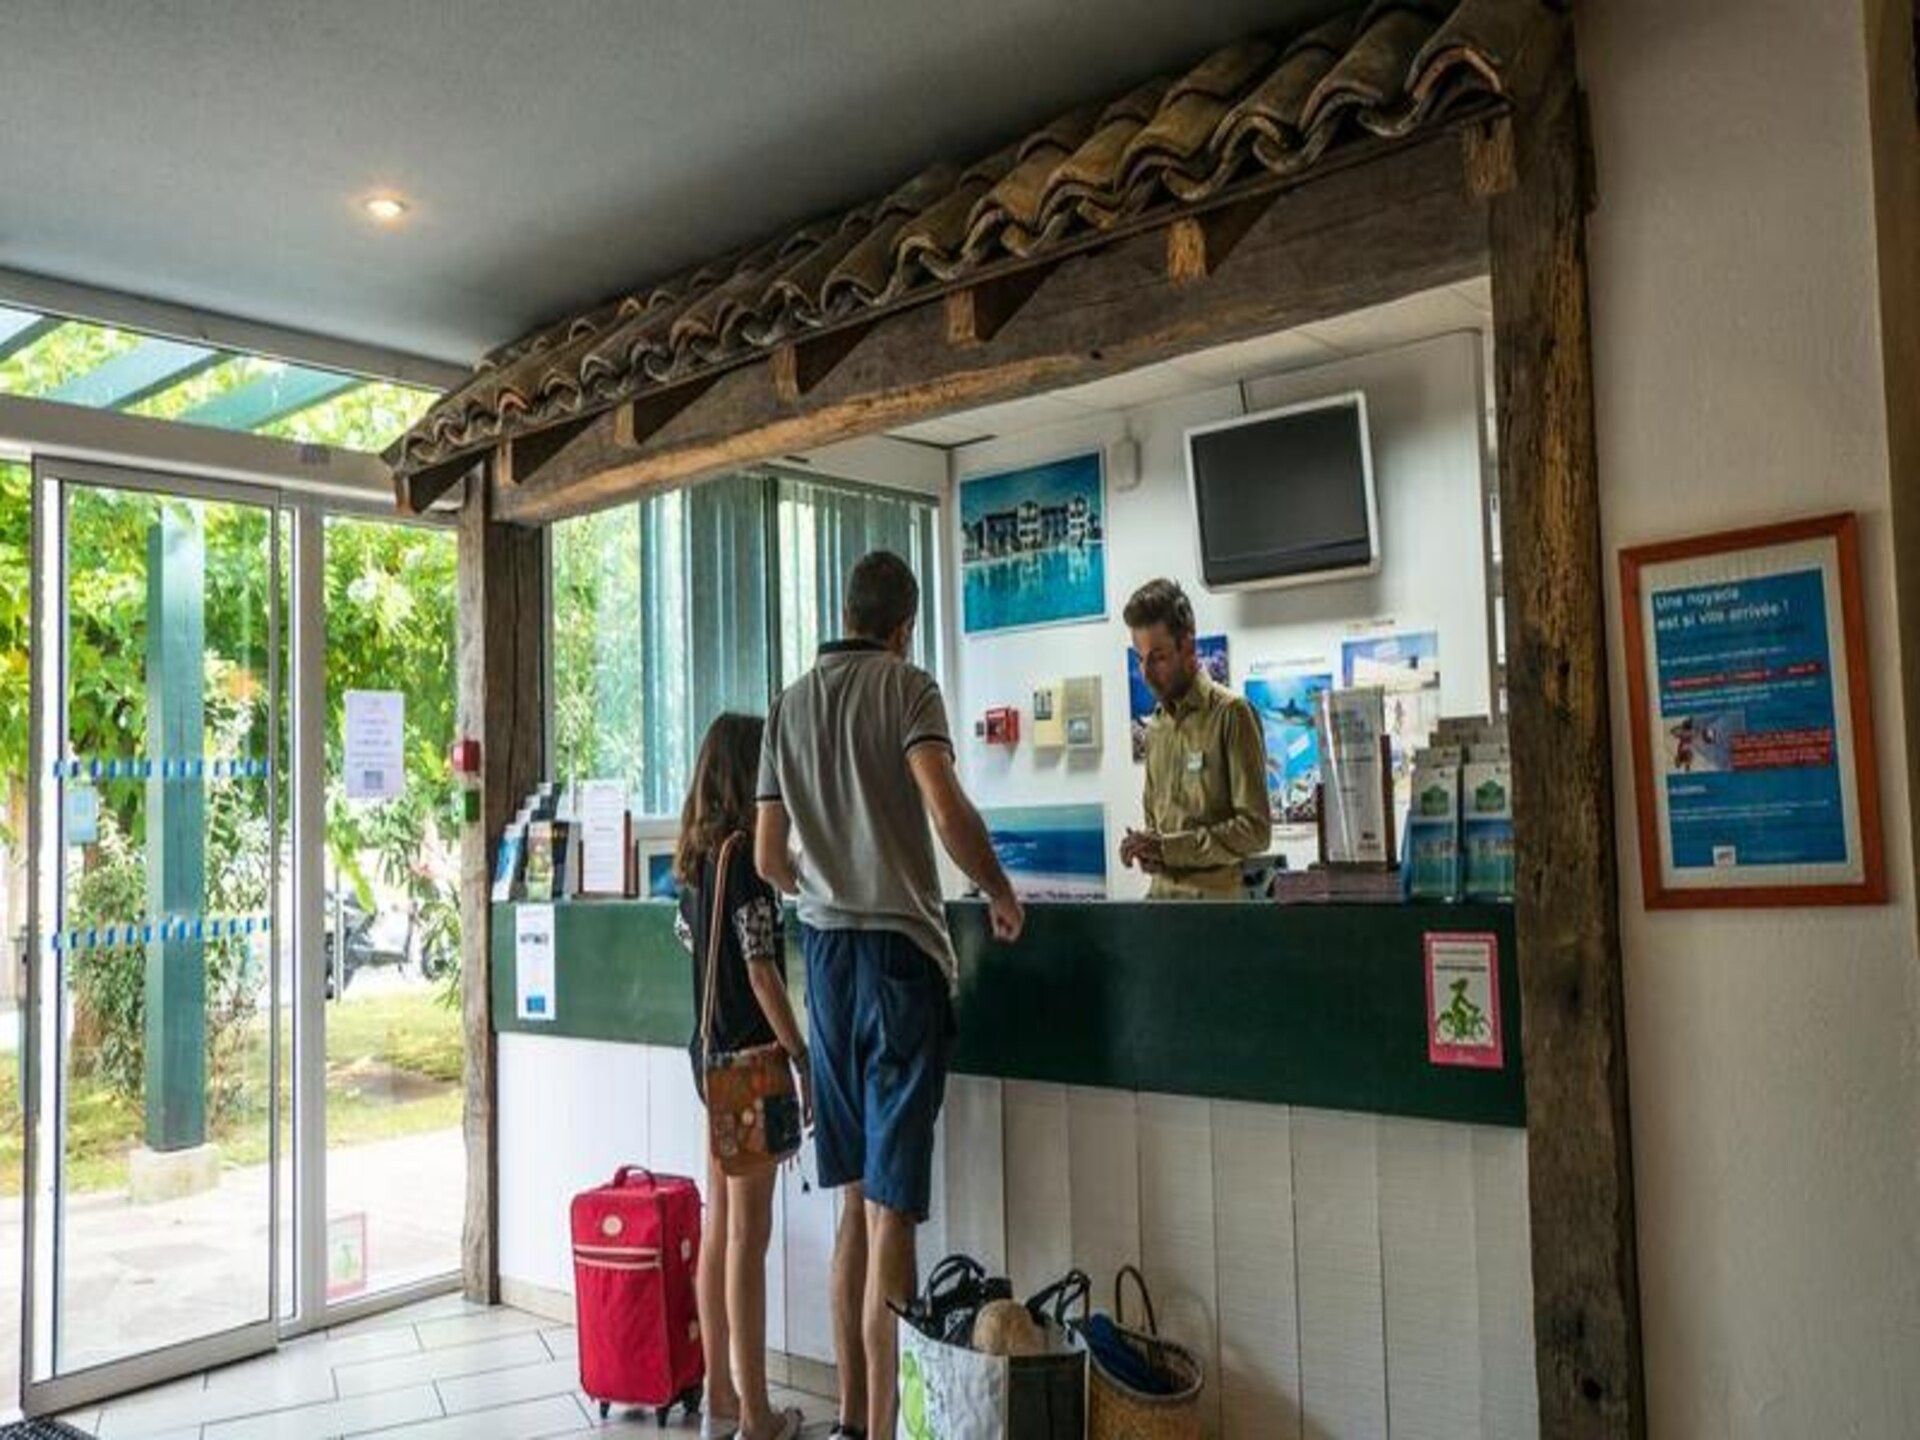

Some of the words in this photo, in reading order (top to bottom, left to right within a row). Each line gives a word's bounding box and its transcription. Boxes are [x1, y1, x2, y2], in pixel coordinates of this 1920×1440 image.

[1656, 594, 1682, 611] Une
[1687, 588, 1739, 607] noyade
[1658, 614, 1680, 630] est
[1684, 611, 1696, 628] si
[1699, 606, 1724, 624] vite
[1729, 601, 1780, 620] arrivée
